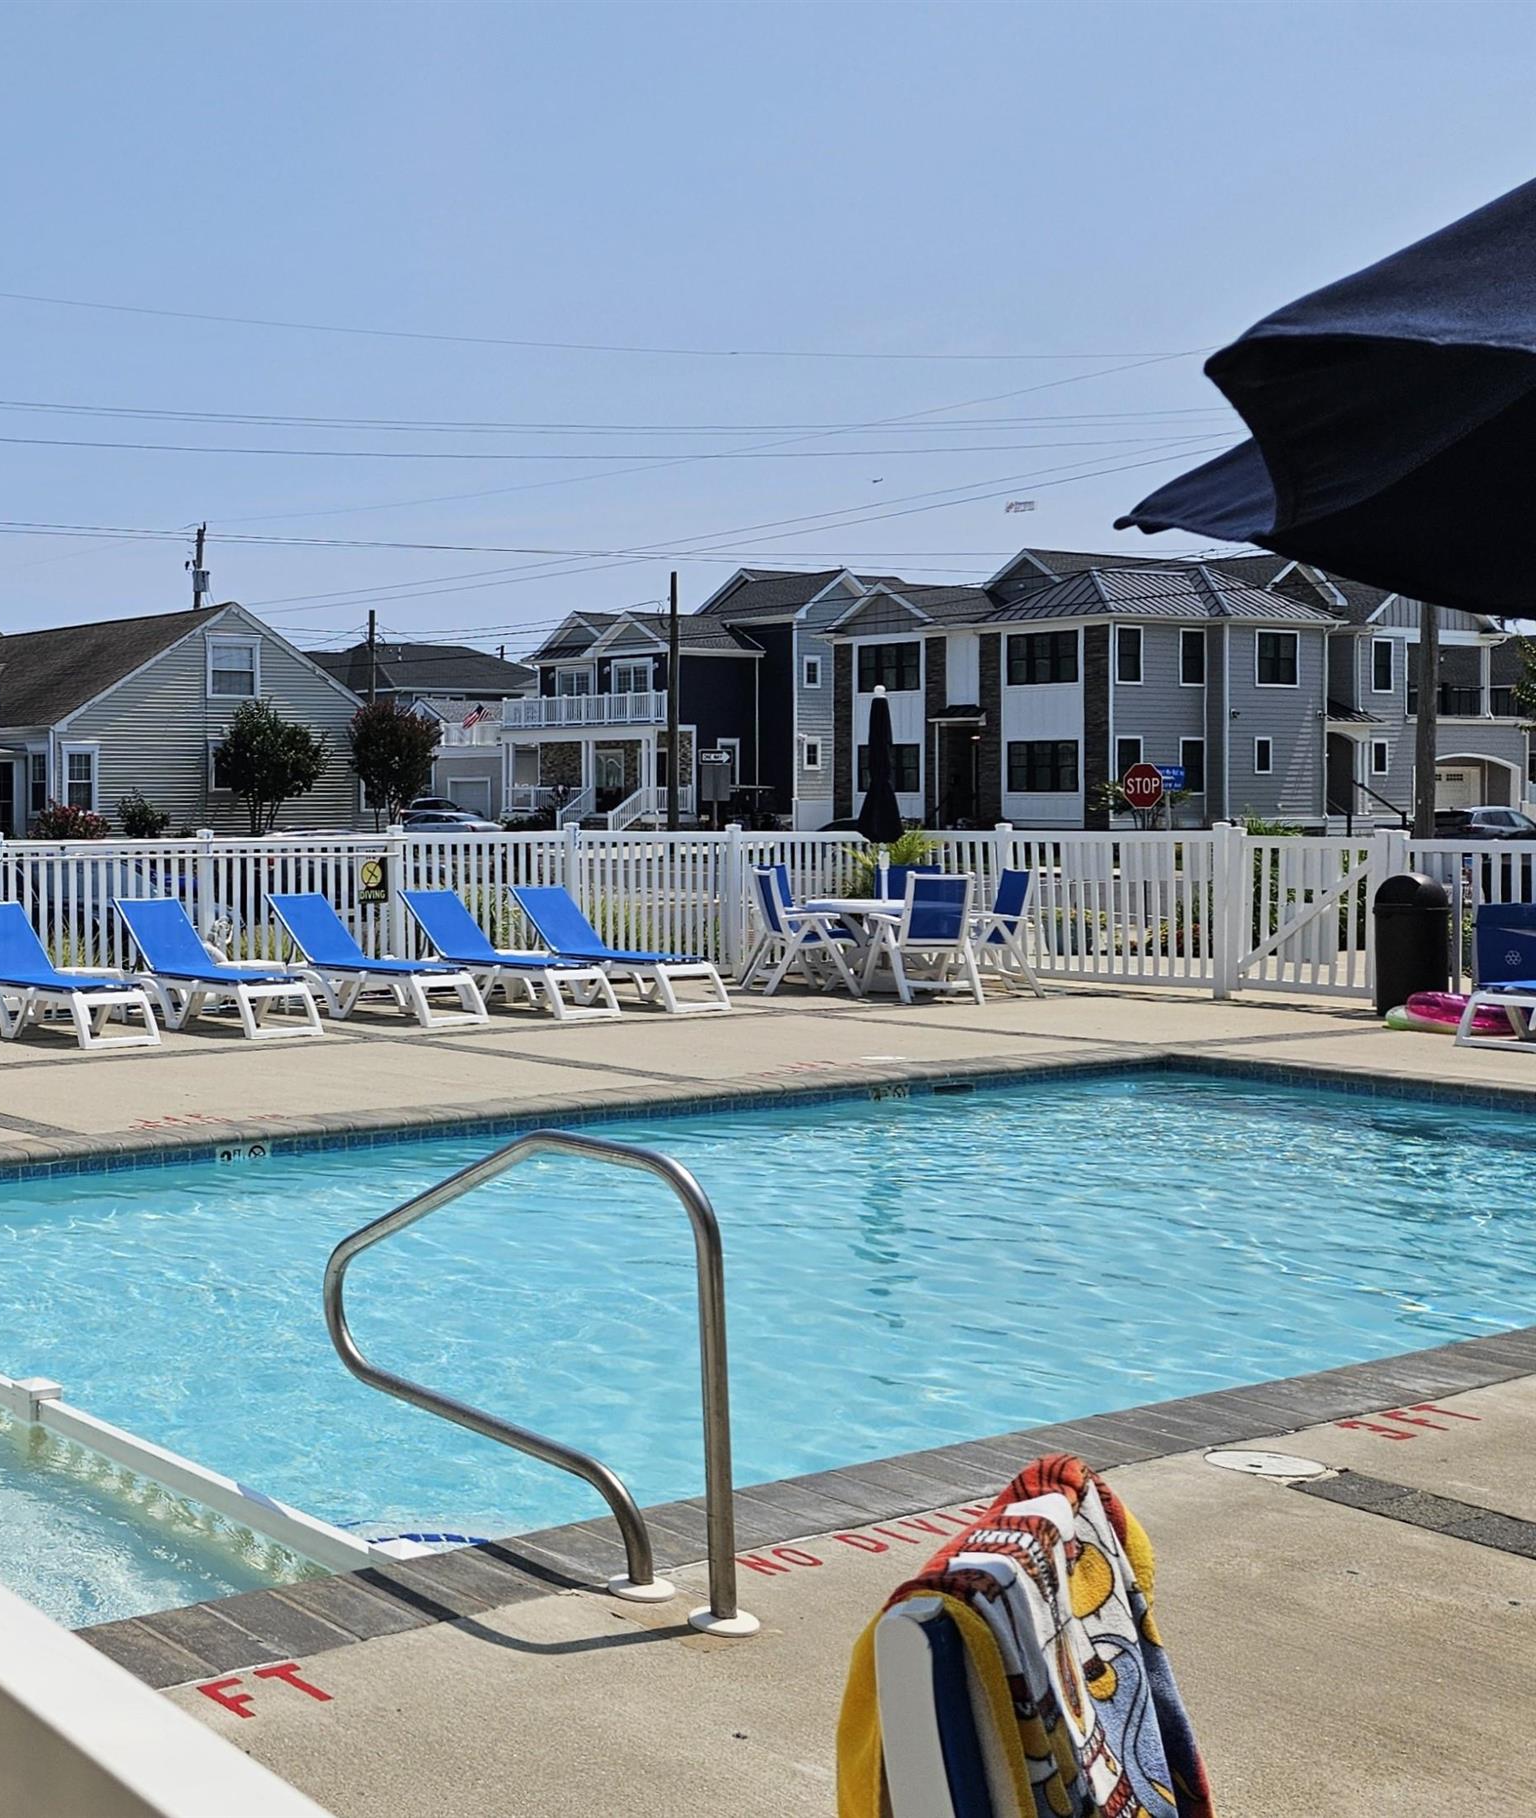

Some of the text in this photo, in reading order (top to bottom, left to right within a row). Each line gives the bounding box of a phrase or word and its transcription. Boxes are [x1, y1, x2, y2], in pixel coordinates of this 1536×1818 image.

[1126, 777, 1160, 794] STOP
[359, 890, 386, 900] DIVING
[1333, 1403, 1483, 1441] 3 FT
[735, 1548, 824, 1576] NO
[195, 1662, 335, 1719] FT
